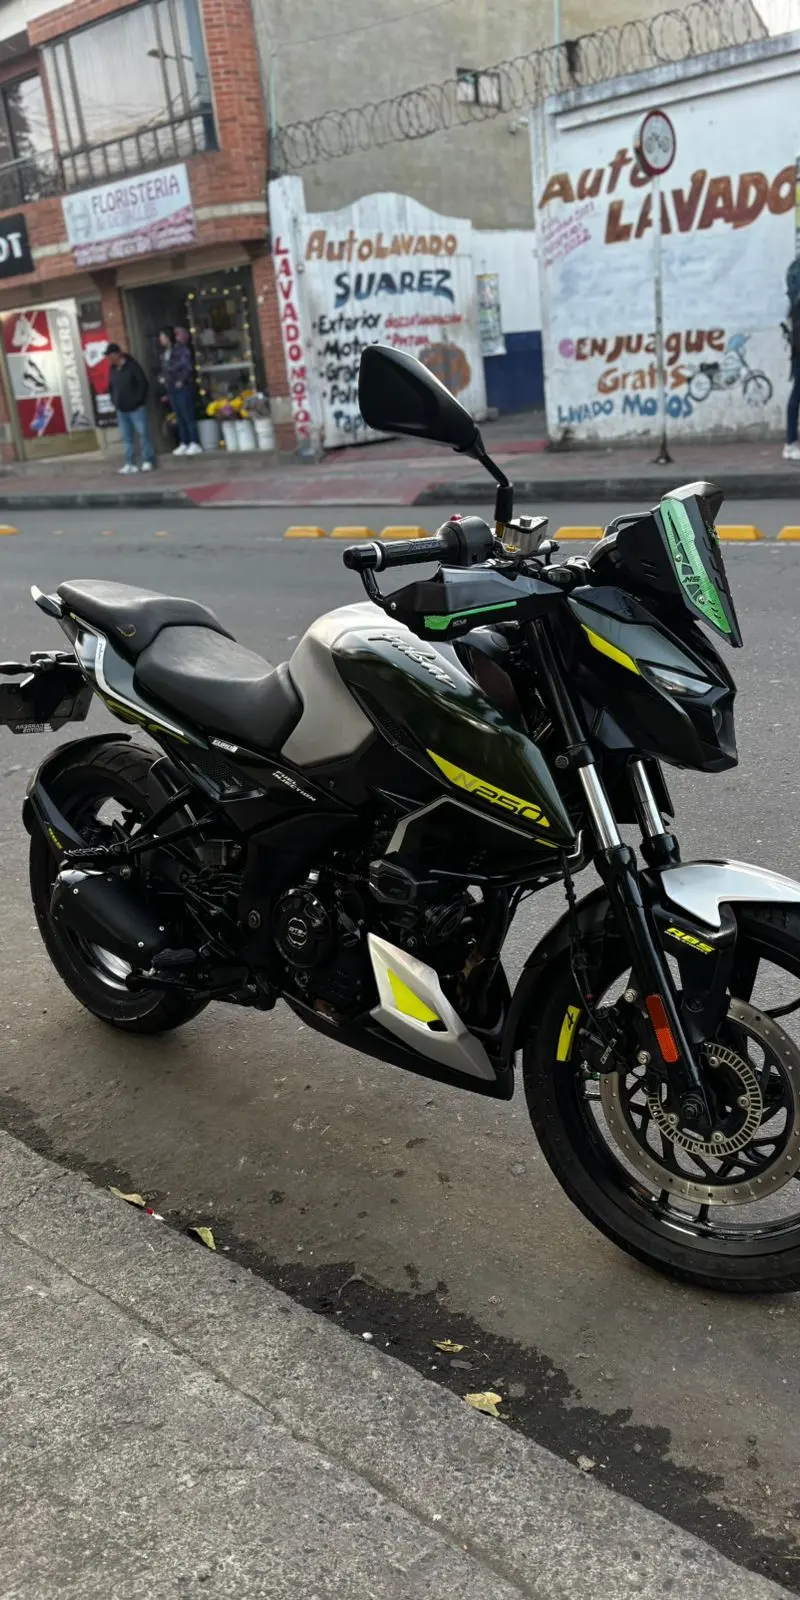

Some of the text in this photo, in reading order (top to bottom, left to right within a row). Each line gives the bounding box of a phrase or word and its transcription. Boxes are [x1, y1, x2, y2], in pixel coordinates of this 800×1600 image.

[91, 173, 180, 216] FLORISTERIA
[604, 164, 796, 245] LAVADO
[274, 236, 304, 361] LAVADO
[334, 269, 455, 308] SUAREZ
[55, 315, 85, 416] SNEAKERS
[271, 772, 317, 802] INJECTION
[276, 770, 297, 786] FUEL
[453, 771, 545, 822] N250
